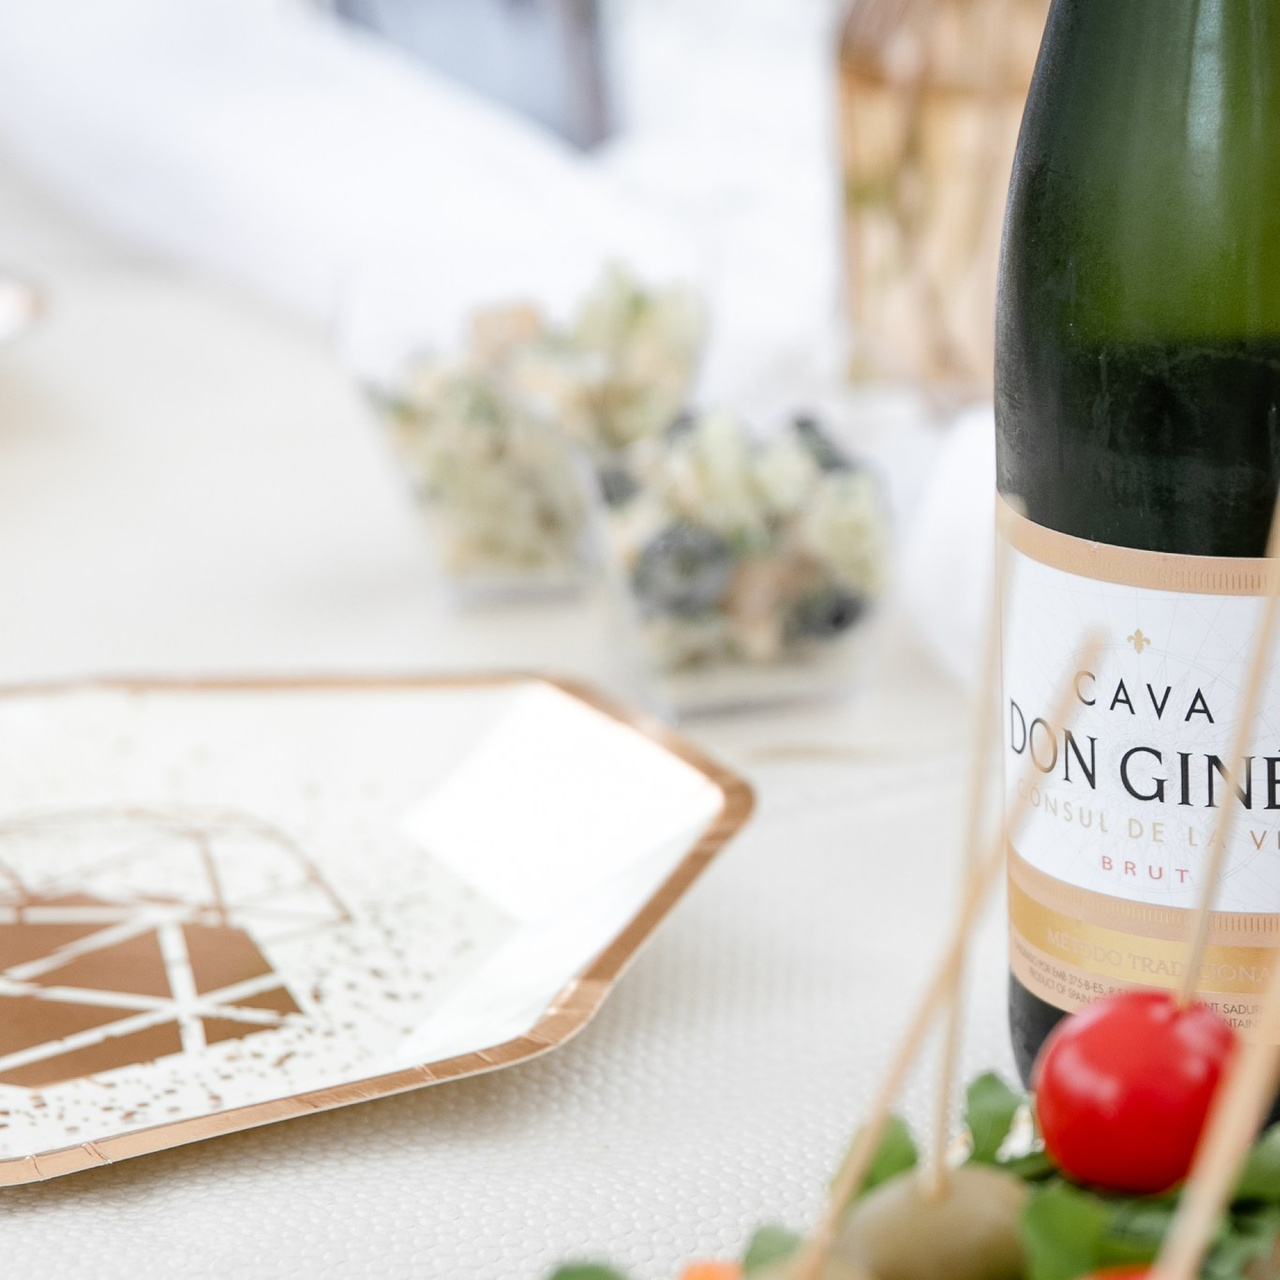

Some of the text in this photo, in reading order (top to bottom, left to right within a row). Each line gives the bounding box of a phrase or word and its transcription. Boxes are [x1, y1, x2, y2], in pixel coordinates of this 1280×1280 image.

[1074, 670, 1215, 724] CAVA
[1010, 698, 1098, 790] DON
[1128, 818, 1165, 843] DE
[1188, 826, 1227, 849] LA
[1101, 855, 1189, 883] BRUT
